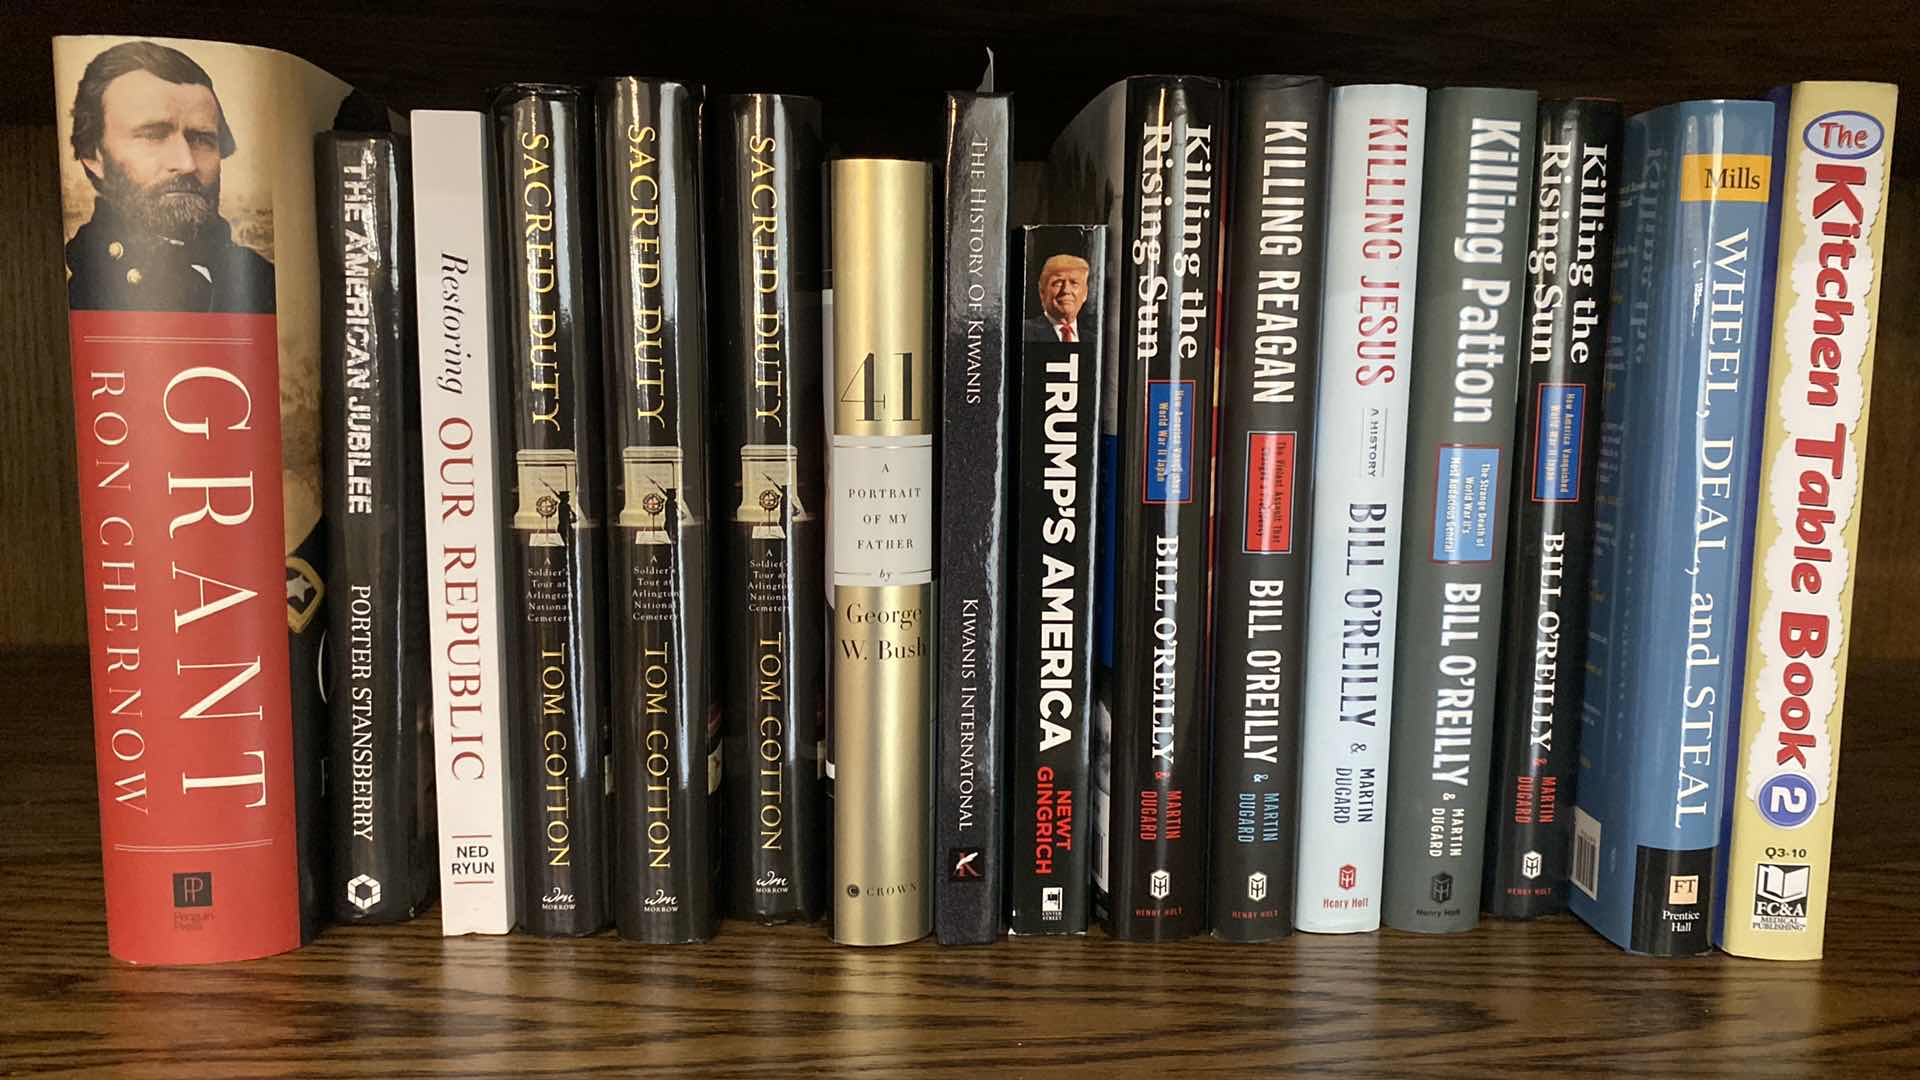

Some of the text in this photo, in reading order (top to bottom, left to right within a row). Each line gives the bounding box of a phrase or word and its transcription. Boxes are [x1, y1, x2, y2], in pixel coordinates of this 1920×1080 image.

[1818, 121, 1868, 148] The
[1704, 167, 1761, 190] Mills
[1133, 121, 1173, 360] Rising Sun
[1173, 123, 1211, 359] Killing the
[1252, 120, 1308, 404] KILLING REAGAN
[1354, 117, 1410, 387] KILLING JESUS
[1527, 141, 1573, 365] Rising Sun
[1567, 142, 1608, 365] Killing the
[521, 131, 561, 433] SACRED DUTY
[628, 125, 666, 429] SACRED DUTY
[749, 135, 783, 429] SACRED DUTY
[966, 135, 990, 406] THE HISTORY OF KIWANIS
[1452, 117, 1522, 424] Killing Patton
[343, 164, 377, 514] THE AMERICAN JUBILEE
[840, 352, 920, 422] 41
[1155, 402, 1168, 482] World War Japan
[1368, 407, 1380, 479] A HISTORY
[1559, 392, 1575, 493] How America Vanquished
[1776, 163, 1868, 768] Kitchen Table Book
[848, 487, 922, 499] PORTRAIT
[881, 463, 890, 473] A
[437, 253, 486, 782] Restoring OUR REPUBLIC
[863, 513, 909, 525] OF MY
[1443, 457, 1461, 553] Most Audacious General
[1463, 476, 1475, 519] World War
[1476, 480, 1489, 512] Strange
[857, 538, 914, 550] FATHER
[1475, 512, 1487, 537] Death
[1675, 227, 1750, 830] WHEEL, DEAL, and STEAL
[544, 556, 552, 566] A
[649, 554, 658, 564] A
[752, 570, 775, 580] Tour
[765, 548, 773, 557] A
[879, 568, 893, 583] by
[1039, 353, 1079, 752] TRUMP'S AMERICA
[89, 368, 150, 815] RON CHERNOW
[162, 366, 267, 808] GRANT
[526, 591, 574, 601] Arlington
[528, 602, 571, 611] Nationa
[531, 579, 566, 589] Tour at
[631, 589, 680, 599] Arlington
[637, 577, 673, 587] Tour at
[846, 601, 922, 631] George
[961, 598, 979, 679] KIWANIS
[1338, 502, 1387, 753] BILL O'REILLY &
[841, 636, 928, 661] W. Bush
[1151, 535, 1179, 779] BILL O'REILLY &
[1530, 532, 1565, 765] BILL O'REILLY &
[1243, 580, 1284, 782] BILL O'REILLY &
[1431, 582, 1482, 801] BILL O'REILLY &
[351, 584, 375, 841] PORTER STANSBERRY
[541, 643, 570, 868] TOM COTTON
[643, 642, 671, 869] TOM COTTON
[758, 632, 783, 851] TOM COTTON
[1035, 766, 1053, 874] GINGRICH
[1056, 789, 1072, 850] NEWT
[1139, 790, 1158, 841] DUGARD
[1165, 789, 1182, 840] MARTIN
[1237, 792, 1256, 843] DUGARD
[1262, 792, 1280, 843] MARTIN
[1332, 767, 1353, 825] DUGARD
[1356, 767, 1377, 823] MARTIN
[1514, 776, 1533, 825] DUGARD
[1538, 776, 1557, 824] MARTIN
[1770, 786, 1806, 816] 2
[456, 845, 490, 860] NED
[1428, 807, 1446, 858] DUGARD
[1449, 808, 1465, 857] MARTIN
[1765, 847, 1807, 859] Q3-10
[451, 861, 496, 876] RYUN
[755, 886, 789, 894] MORROW
[866, 880, 921, 897] CROWN
[1674, 880, 1696, 893] FT
[541, 903, 576, 911] MORROW
[643, 905, 679, 913] MORROW
[1323, 897, 1369, 909] Henry Holt
[1662, 909, 1701, 921] Prentice
[1671, 922, 1692, 932] Hall
[1755, 901, 1805, 916] FC&A
